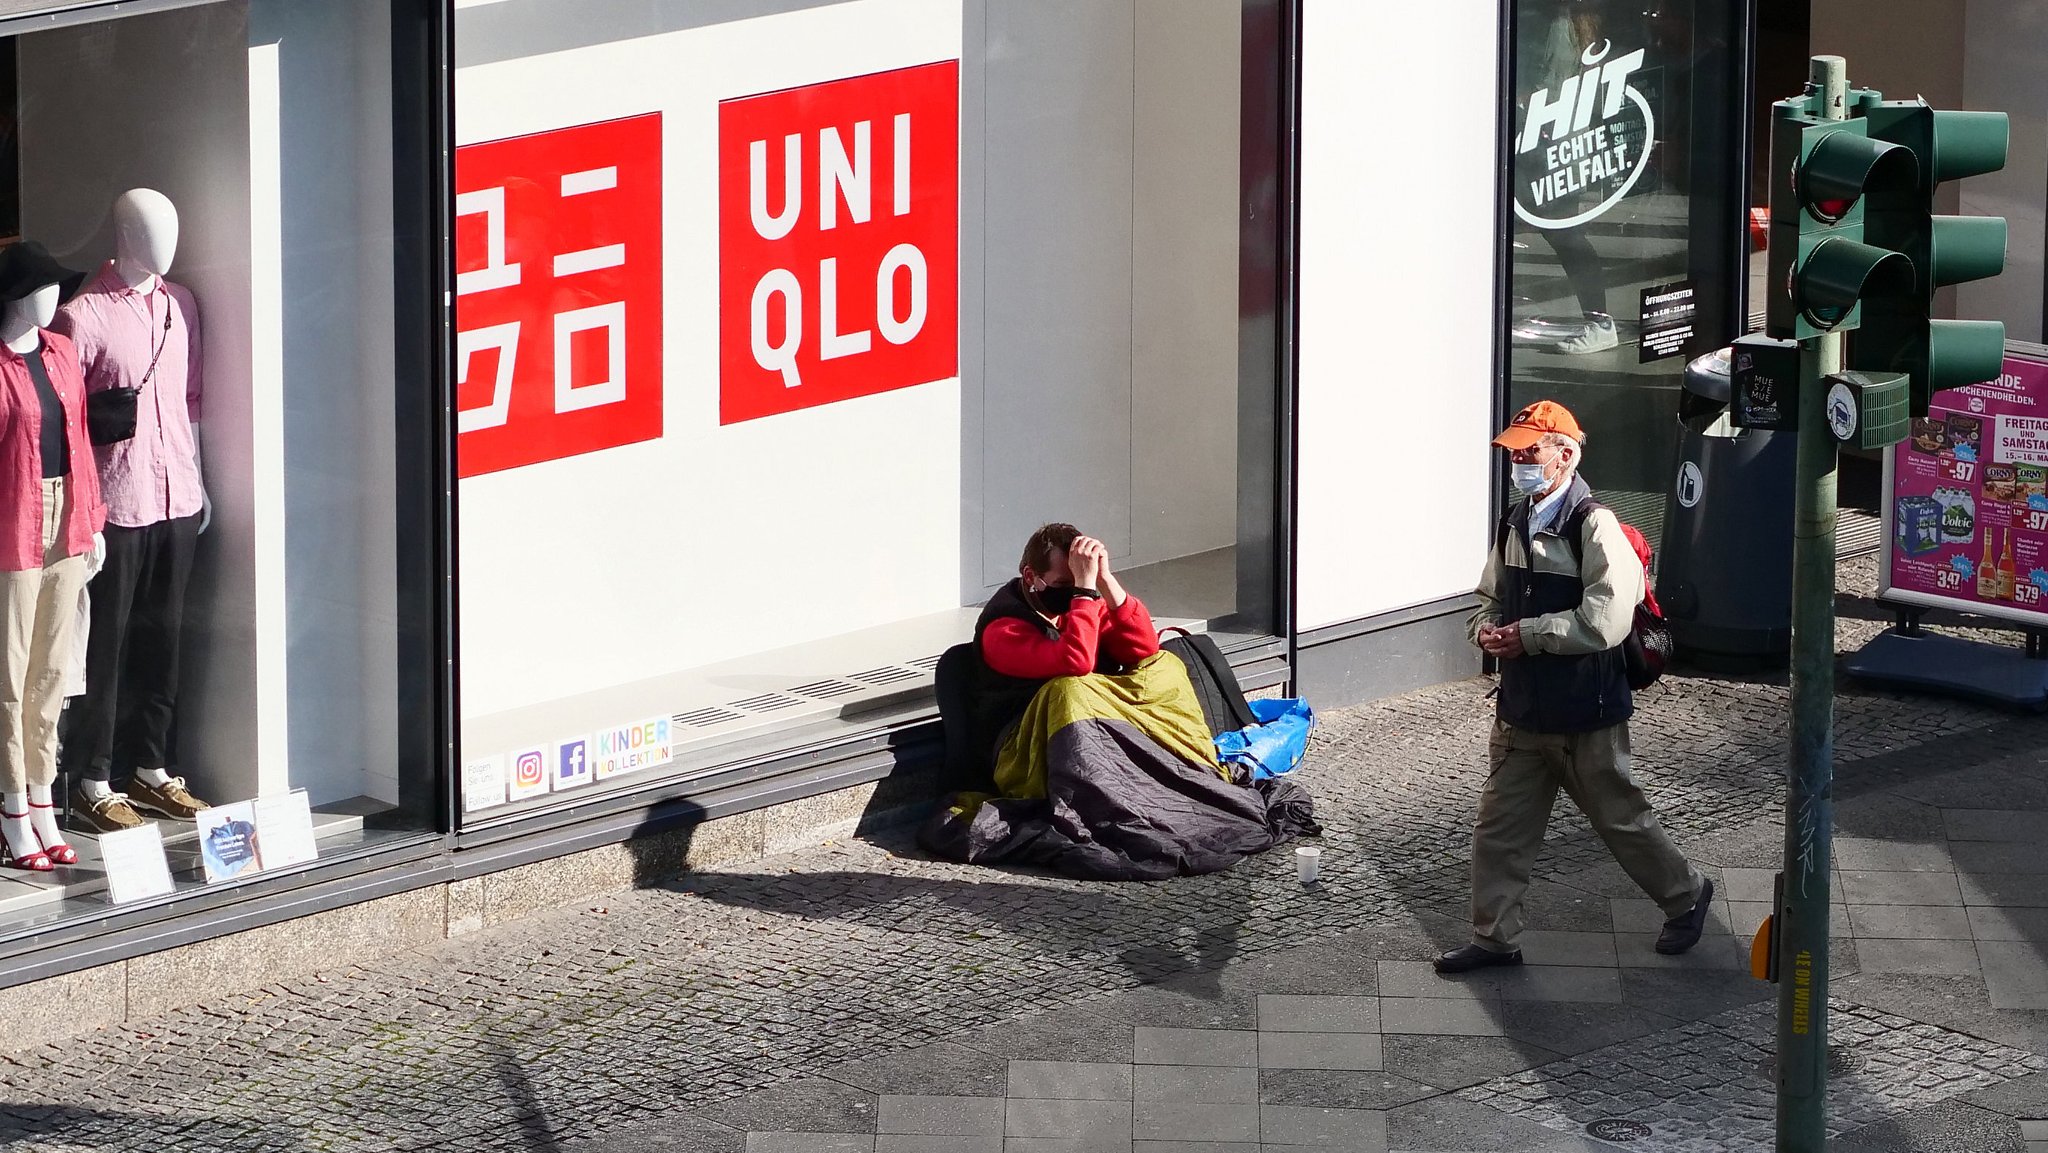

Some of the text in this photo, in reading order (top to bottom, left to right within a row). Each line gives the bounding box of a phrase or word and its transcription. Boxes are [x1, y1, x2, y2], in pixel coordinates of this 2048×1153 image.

[1546, 125, 1608, 171] ECHTE
[750, 113, 911, 241] UNI
[1531, 145, 1632, 207] VIELFALT.
[1645, 288, 1693, 306] ÖFFNUNGSZEITEN
[750, 243, 929, 389] QLO
[1754, 375, 1774, 387] MUE
[1751, 391, 1770, 403] MUE
[2005, 418, 2048, 431] FREITAG
[2020, 430, 2036, 439] UND
[1984, 466, 2012, 478] CORNY
[1942, 514, 1972, 528] Volvic
[1937, 570, 1961, 589] 3.47
[2015, 584, 2039, 603] 5.79
[600, 719, 669, 757] KINDER
[467, 763, 491, 775] Folgen
[469, 794, 490, 806] Follow
[1795, 969, 1810, 986] ON
[1793, 988, 1809, 1034] WHEELS
